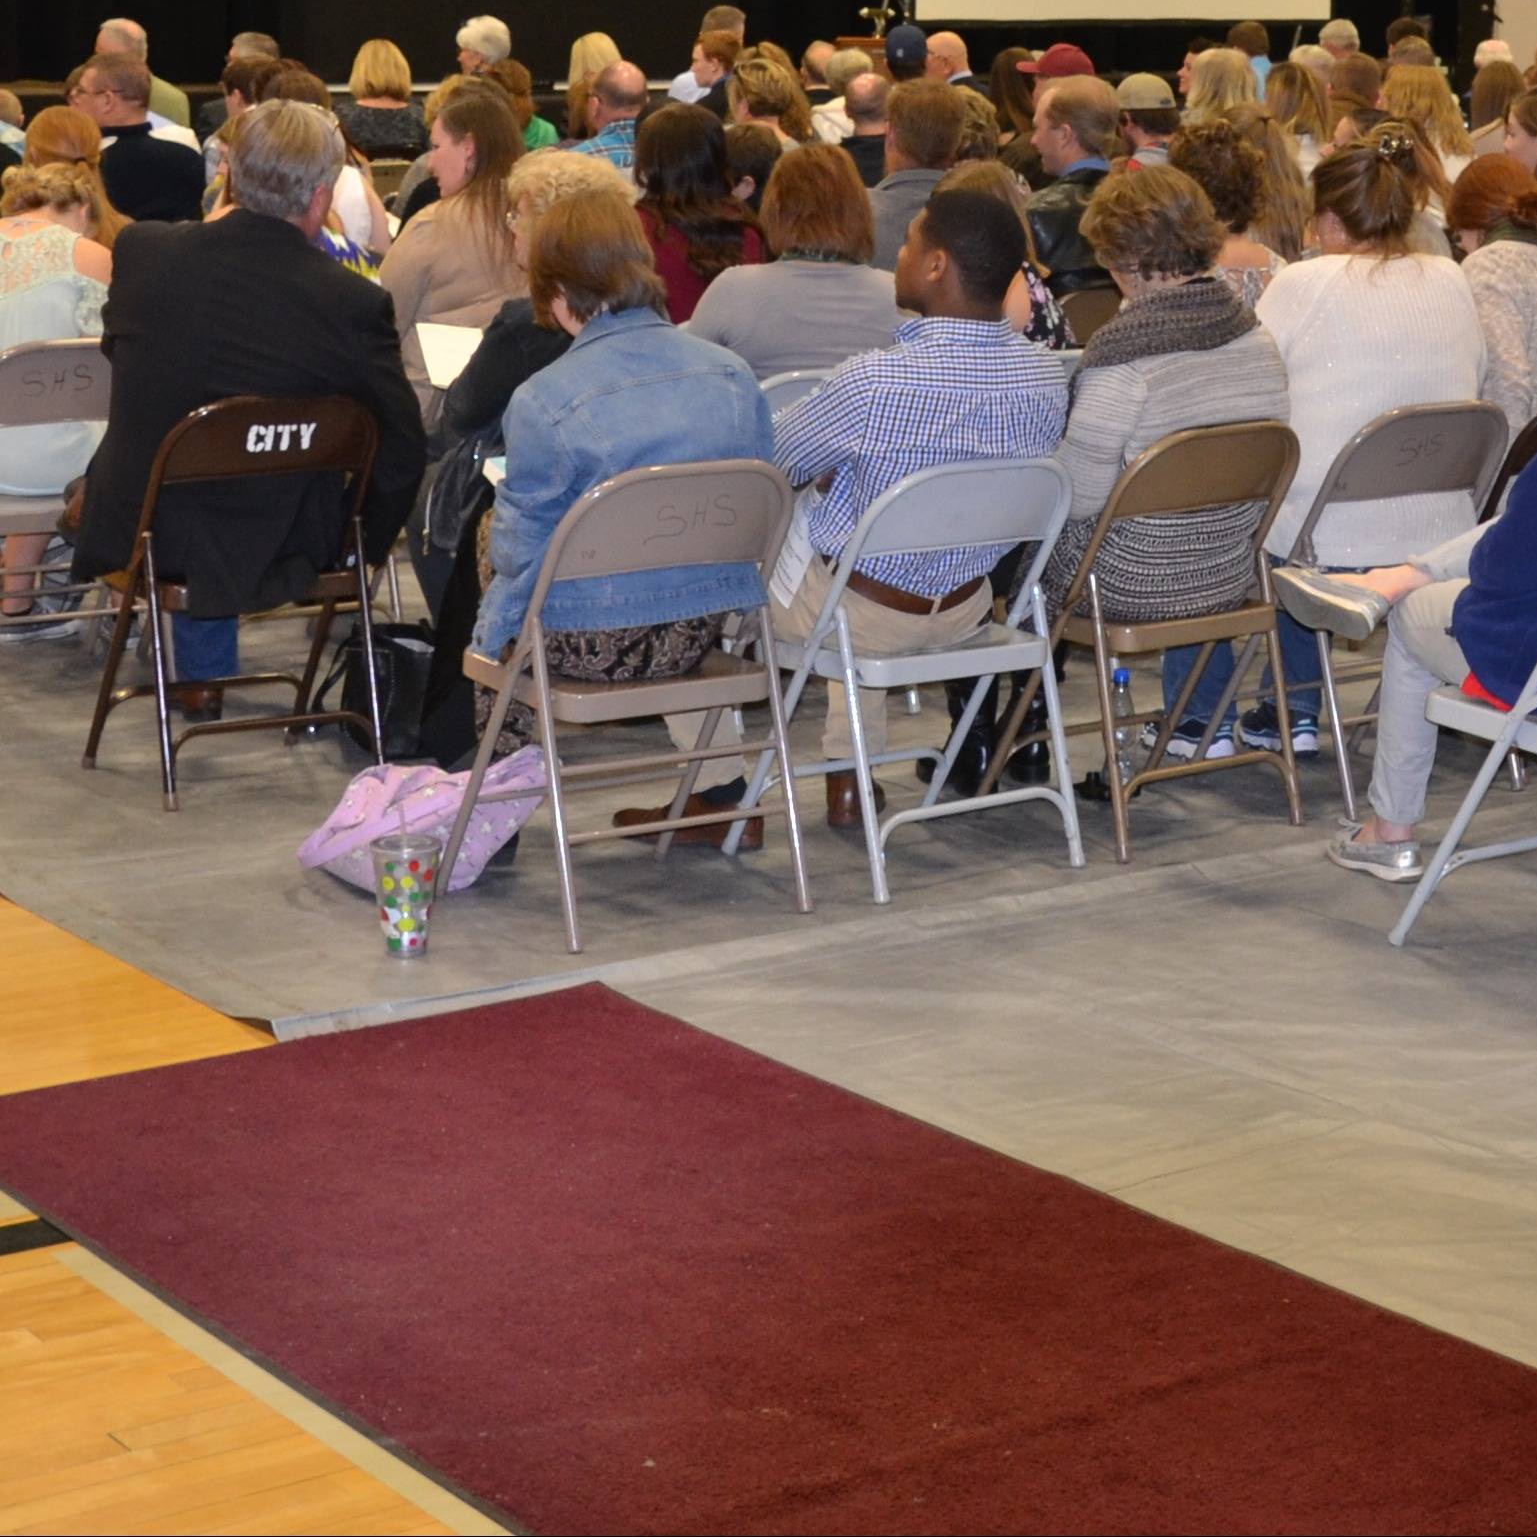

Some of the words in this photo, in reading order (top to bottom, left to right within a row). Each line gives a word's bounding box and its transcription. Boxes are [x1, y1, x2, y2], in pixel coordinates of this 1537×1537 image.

[22, 363, 94, 398] SHS
[246, 422, 318, 453] CITY
[1397, 433, 1444, 466] SHS
[643, 494, 737, 546] SHS
